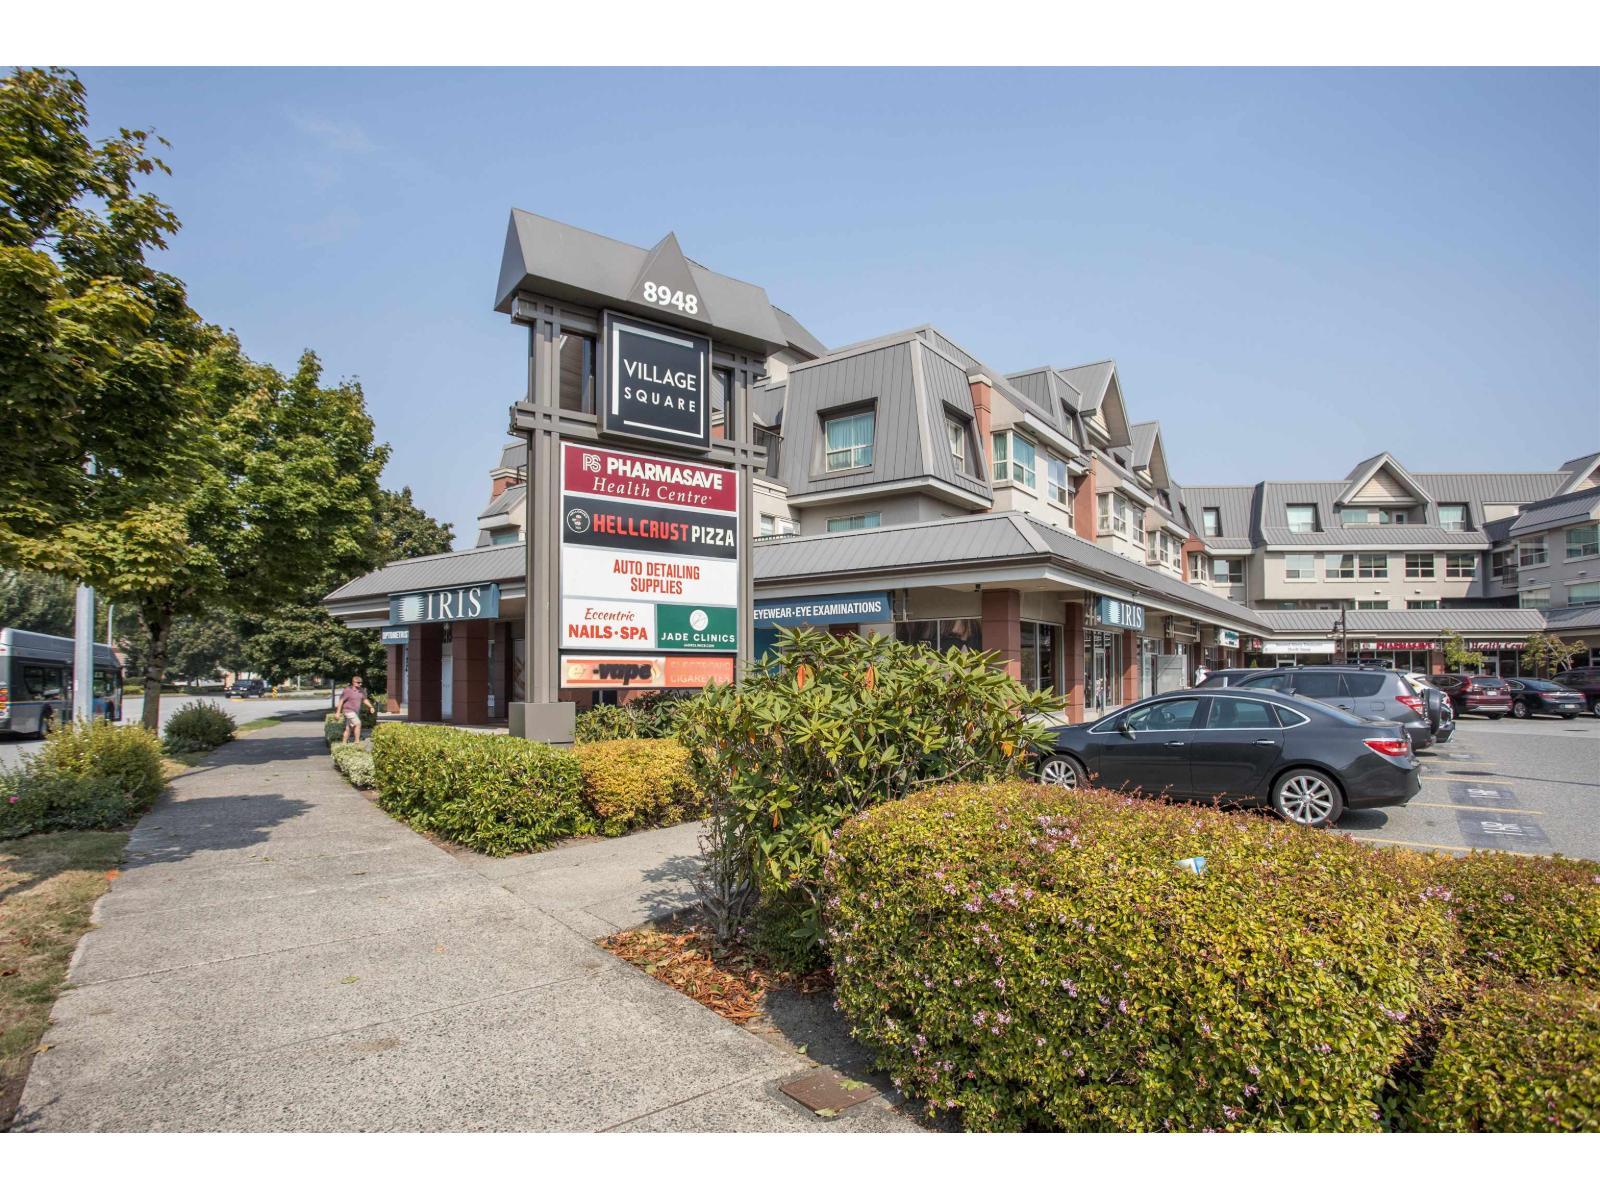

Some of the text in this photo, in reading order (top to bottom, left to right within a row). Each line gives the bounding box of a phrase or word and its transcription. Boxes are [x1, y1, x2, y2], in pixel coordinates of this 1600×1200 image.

[643, 281, 698, 315] 8948
[623, 359, 697, 391] VILLAGE
[624, 387, 696, 413] SQUARE
[607, 457, 722, 490] PHARMASAVE
[593, 477, 708, 505] Health Centre
[593, 514, 735, 547] HELLCRUST PIZZA
[613, 559, 700, 580] AUTO DETAILING
[631, 578, 683, 595] SUPPLIES
[426, 587, 481, 620] IRIS
[584, 608, 635, 622] Eccentric
[813, 601, 882, 616] EXAMINATIONS
[1121, 603, 1142, 628] IRIS
[568, 624, 648, 640] NAILS SPA
[661, 633, 735, 642] JADE CLINICS
